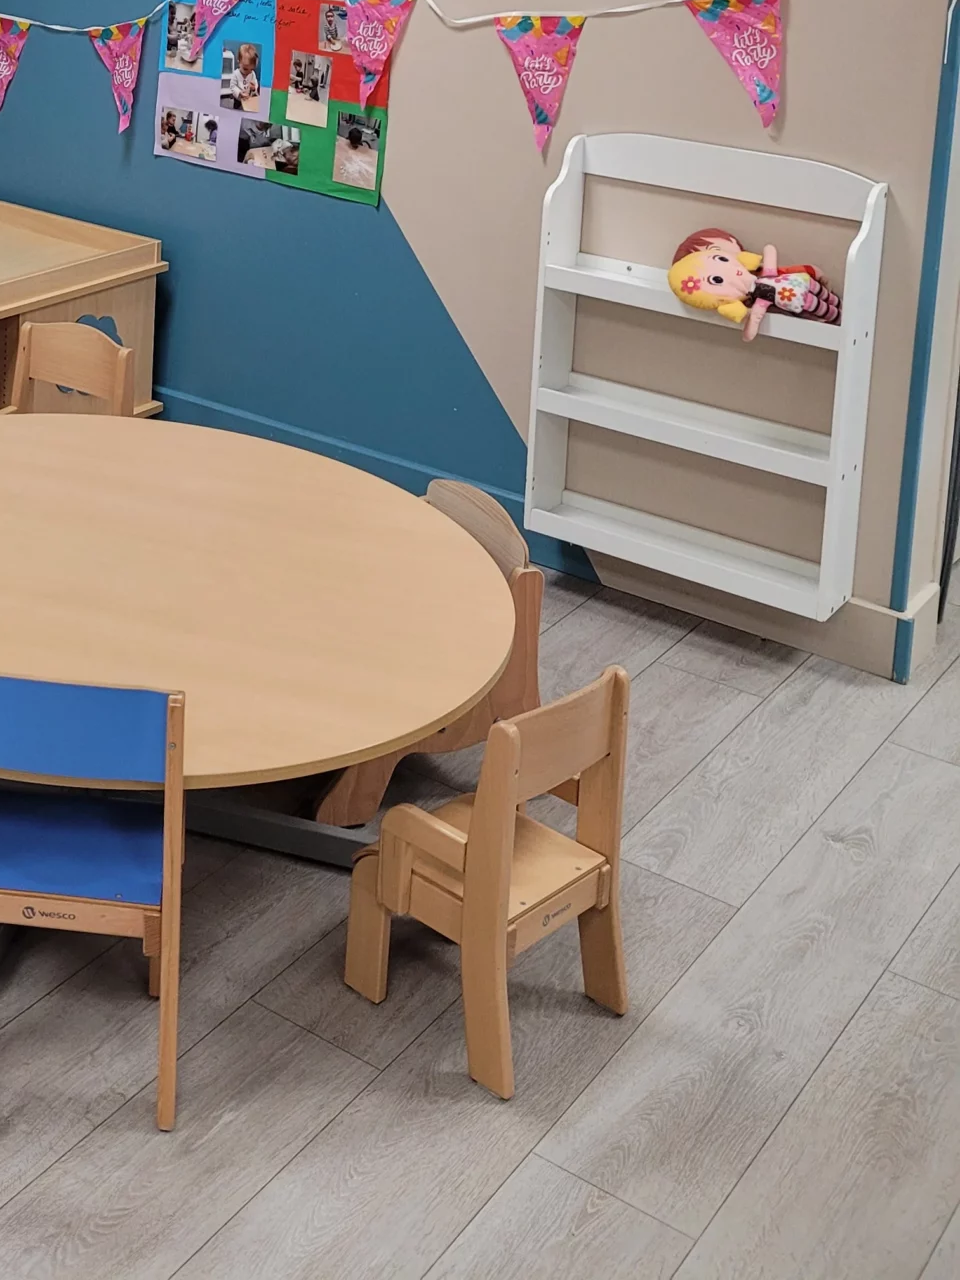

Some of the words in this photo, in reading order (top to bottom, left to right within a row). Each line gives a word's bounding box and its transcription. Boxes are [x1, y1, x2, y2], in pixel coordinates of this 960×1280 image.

[351, 35, 388, 59] Party
[731, 37, 777, 69] Party
[520, 66, 563, 94] Party
[38, 910, 77, 921] wesco
